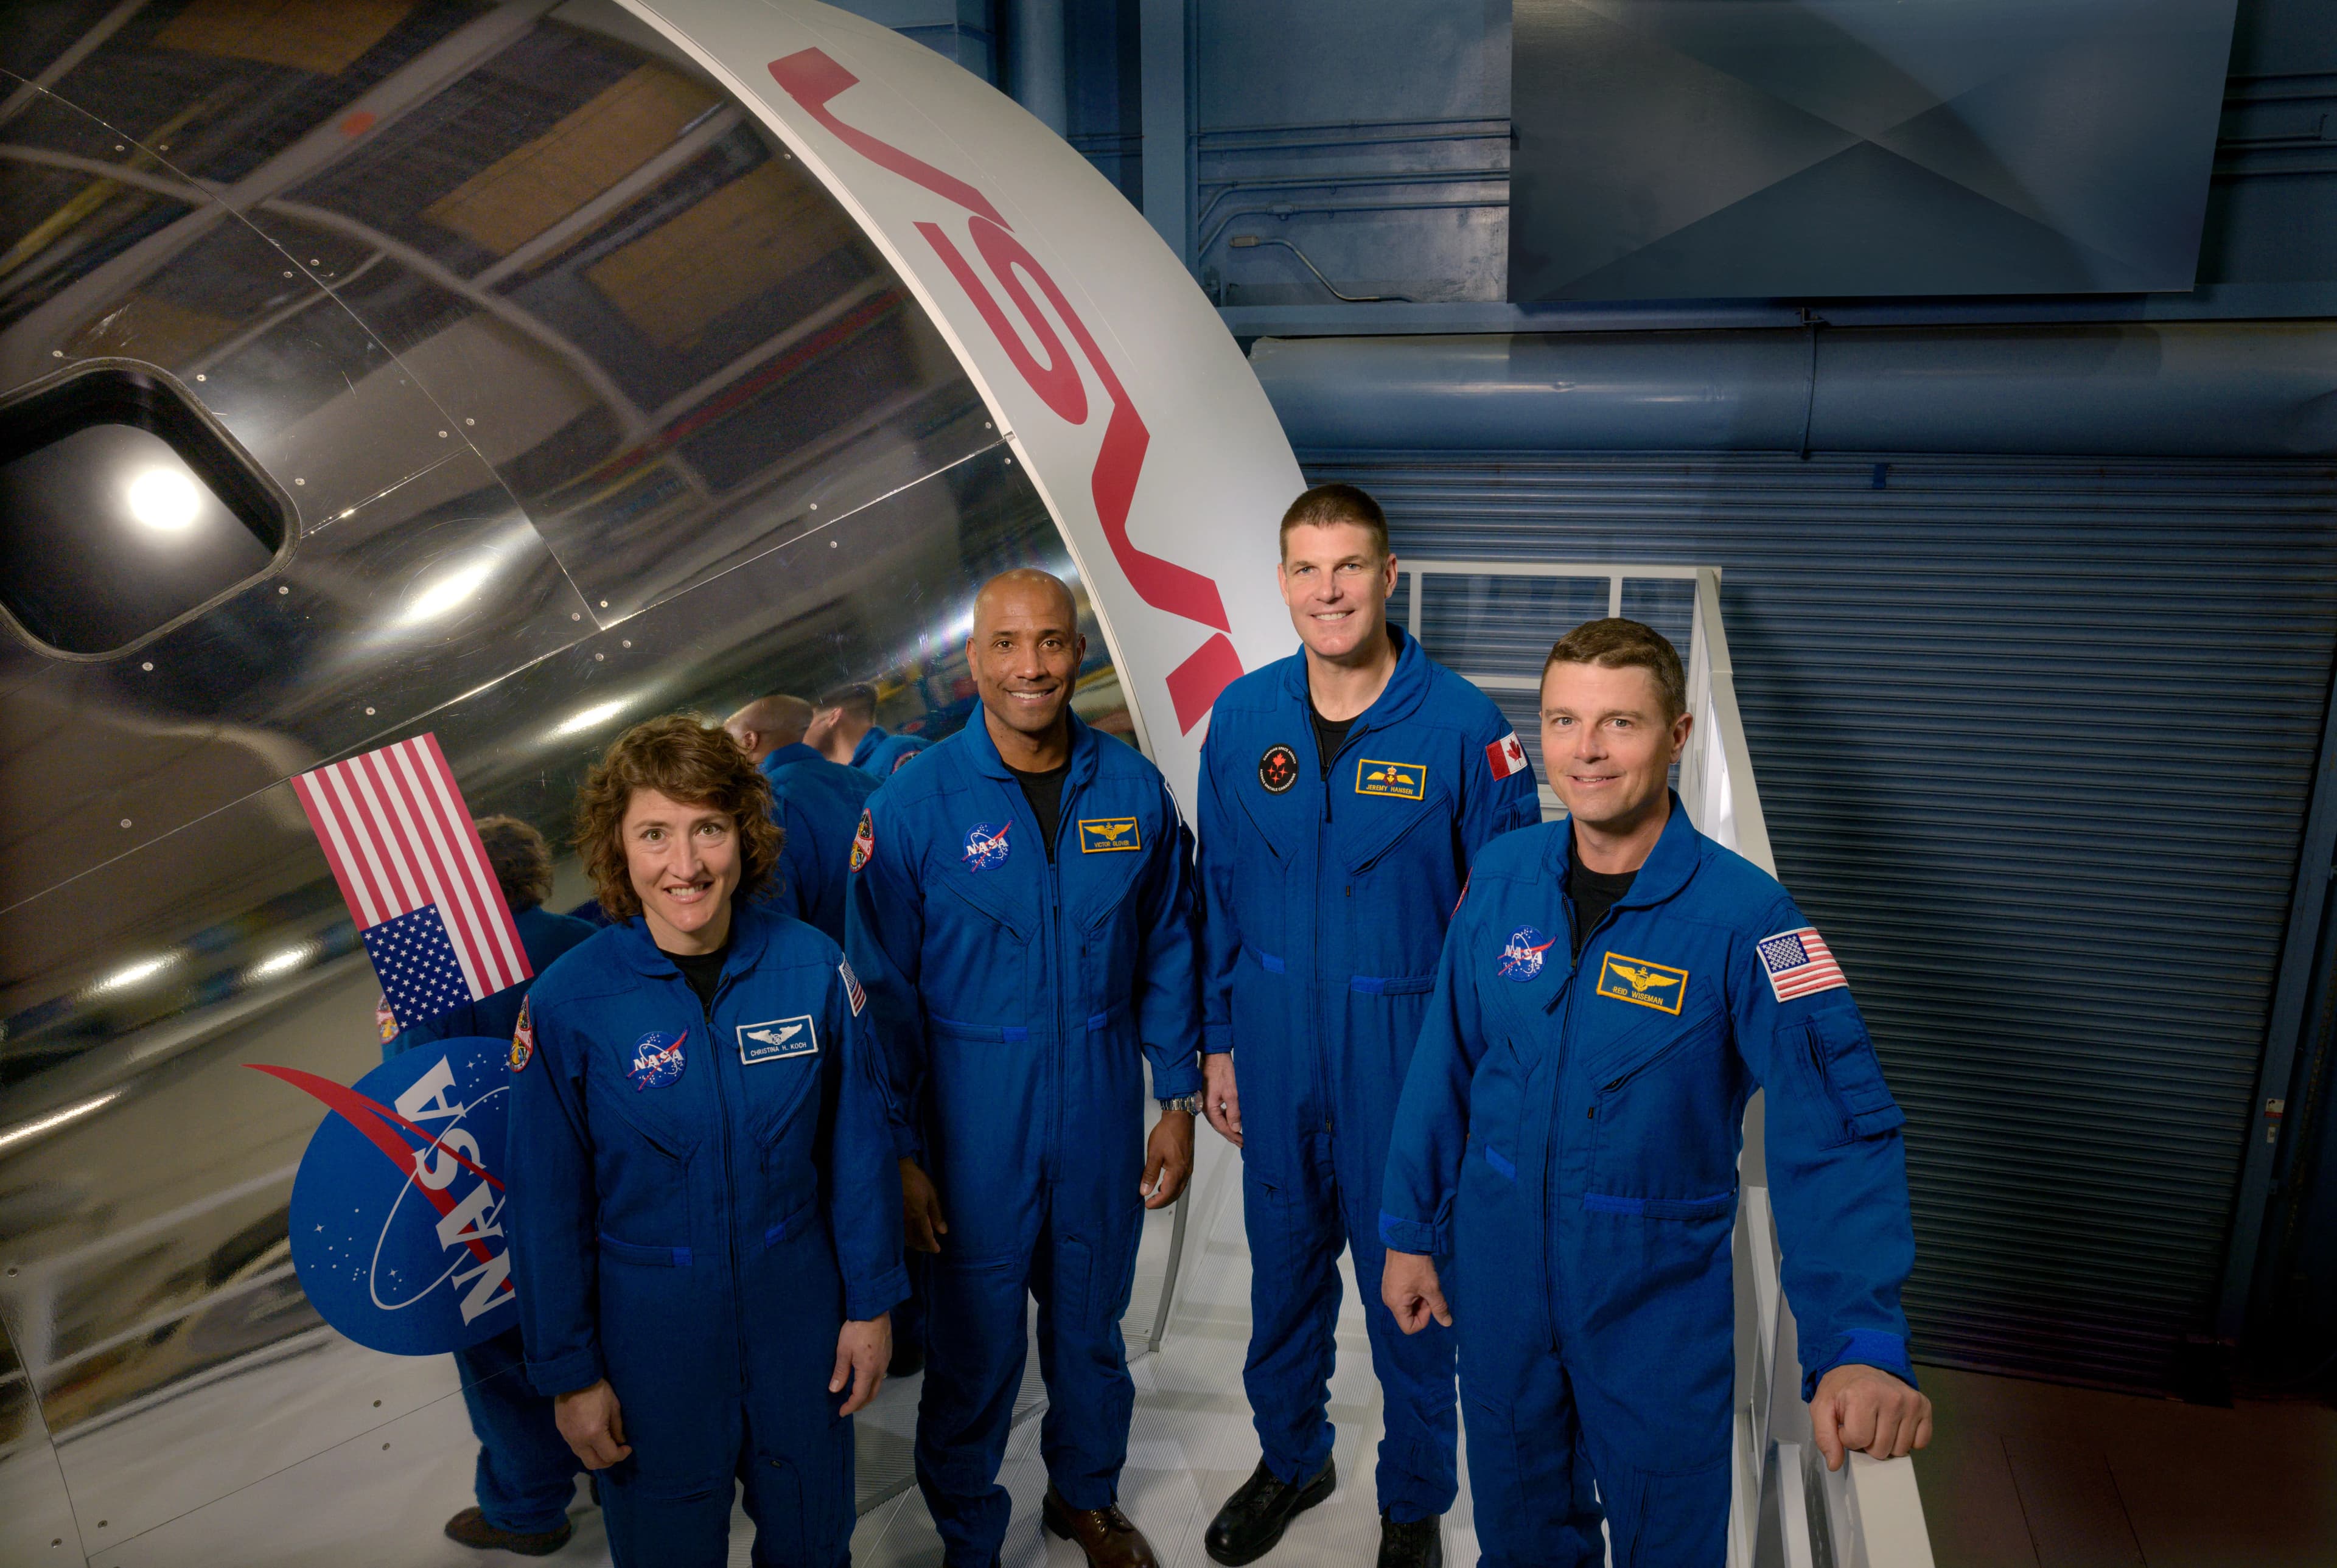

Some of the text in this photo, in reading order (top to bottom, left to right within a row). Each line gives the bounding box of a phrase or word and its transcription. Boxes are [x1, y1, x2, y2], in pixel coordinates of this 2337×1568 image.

[1391, 786, 1413, 795] HANSEN
[966, 837, 1008, 856] NASA
[1504, 944, 1543, 965] NASA
[1612, 986, 1663, 1005] REID WISEMAN
[633, 1049, 684, 1071] NASA
[750, 1046, 779, 1057] CHRISTINA
[394, 1054, 516, 1327] NASA
